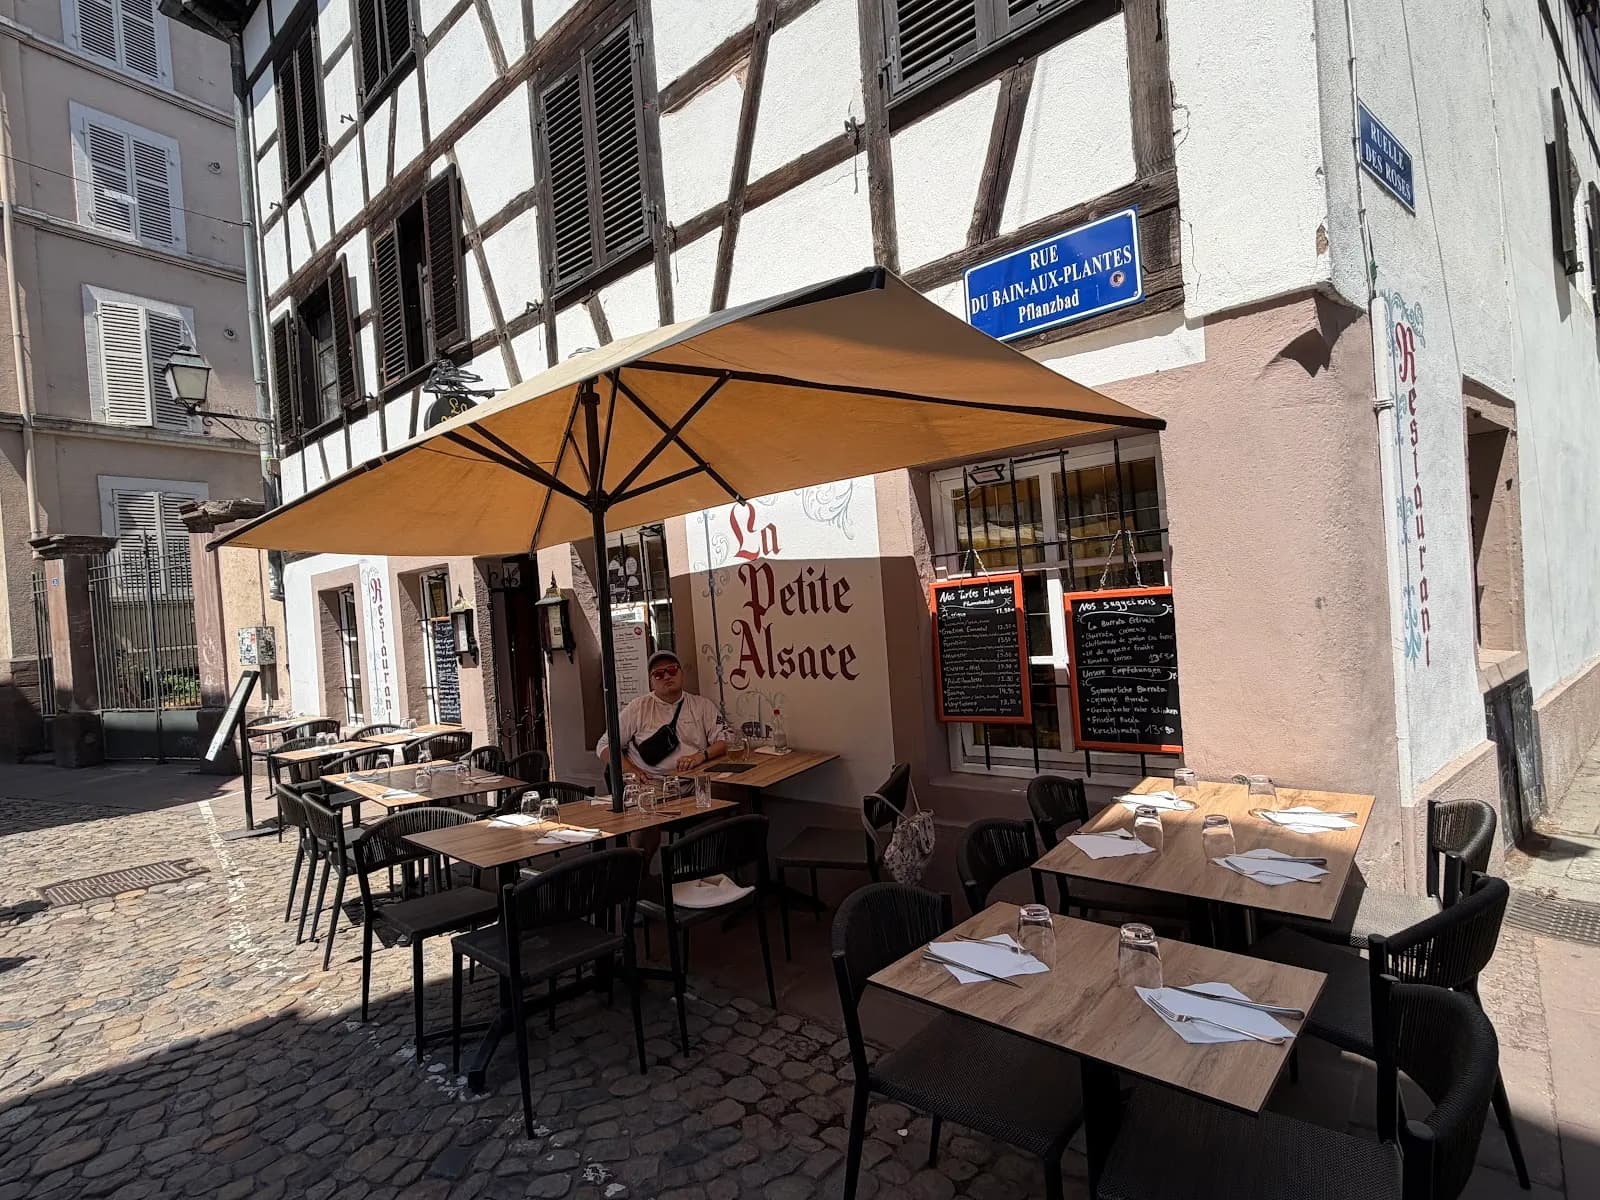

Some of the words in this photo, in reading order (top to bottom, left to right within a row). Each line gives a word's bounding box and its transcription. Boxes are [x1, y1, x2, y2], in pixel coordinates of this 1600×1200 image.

[1365, 142, 1382, 174] DES
[1370, 121, 1404, 170] RUELLE
[1386, 162, 1410, 200] ROSES
[1030, 244, 1059, 270] RUE
[970, 294, 988, 314] DU
[992, 244, 1132, 308] BAIN-AUX-PLANTES
[1018, 288, 1080, 324] Pflanzbad
[1395, 322, 1431, 668] Restaurant
[730, 502, 782, 560] La
[738, 562, 854, 634] Petite
[940, 592, 955, 603] Nos
[1079, 602, 1096, 612] Nos
[730, 619, 860, 690] Alsace
